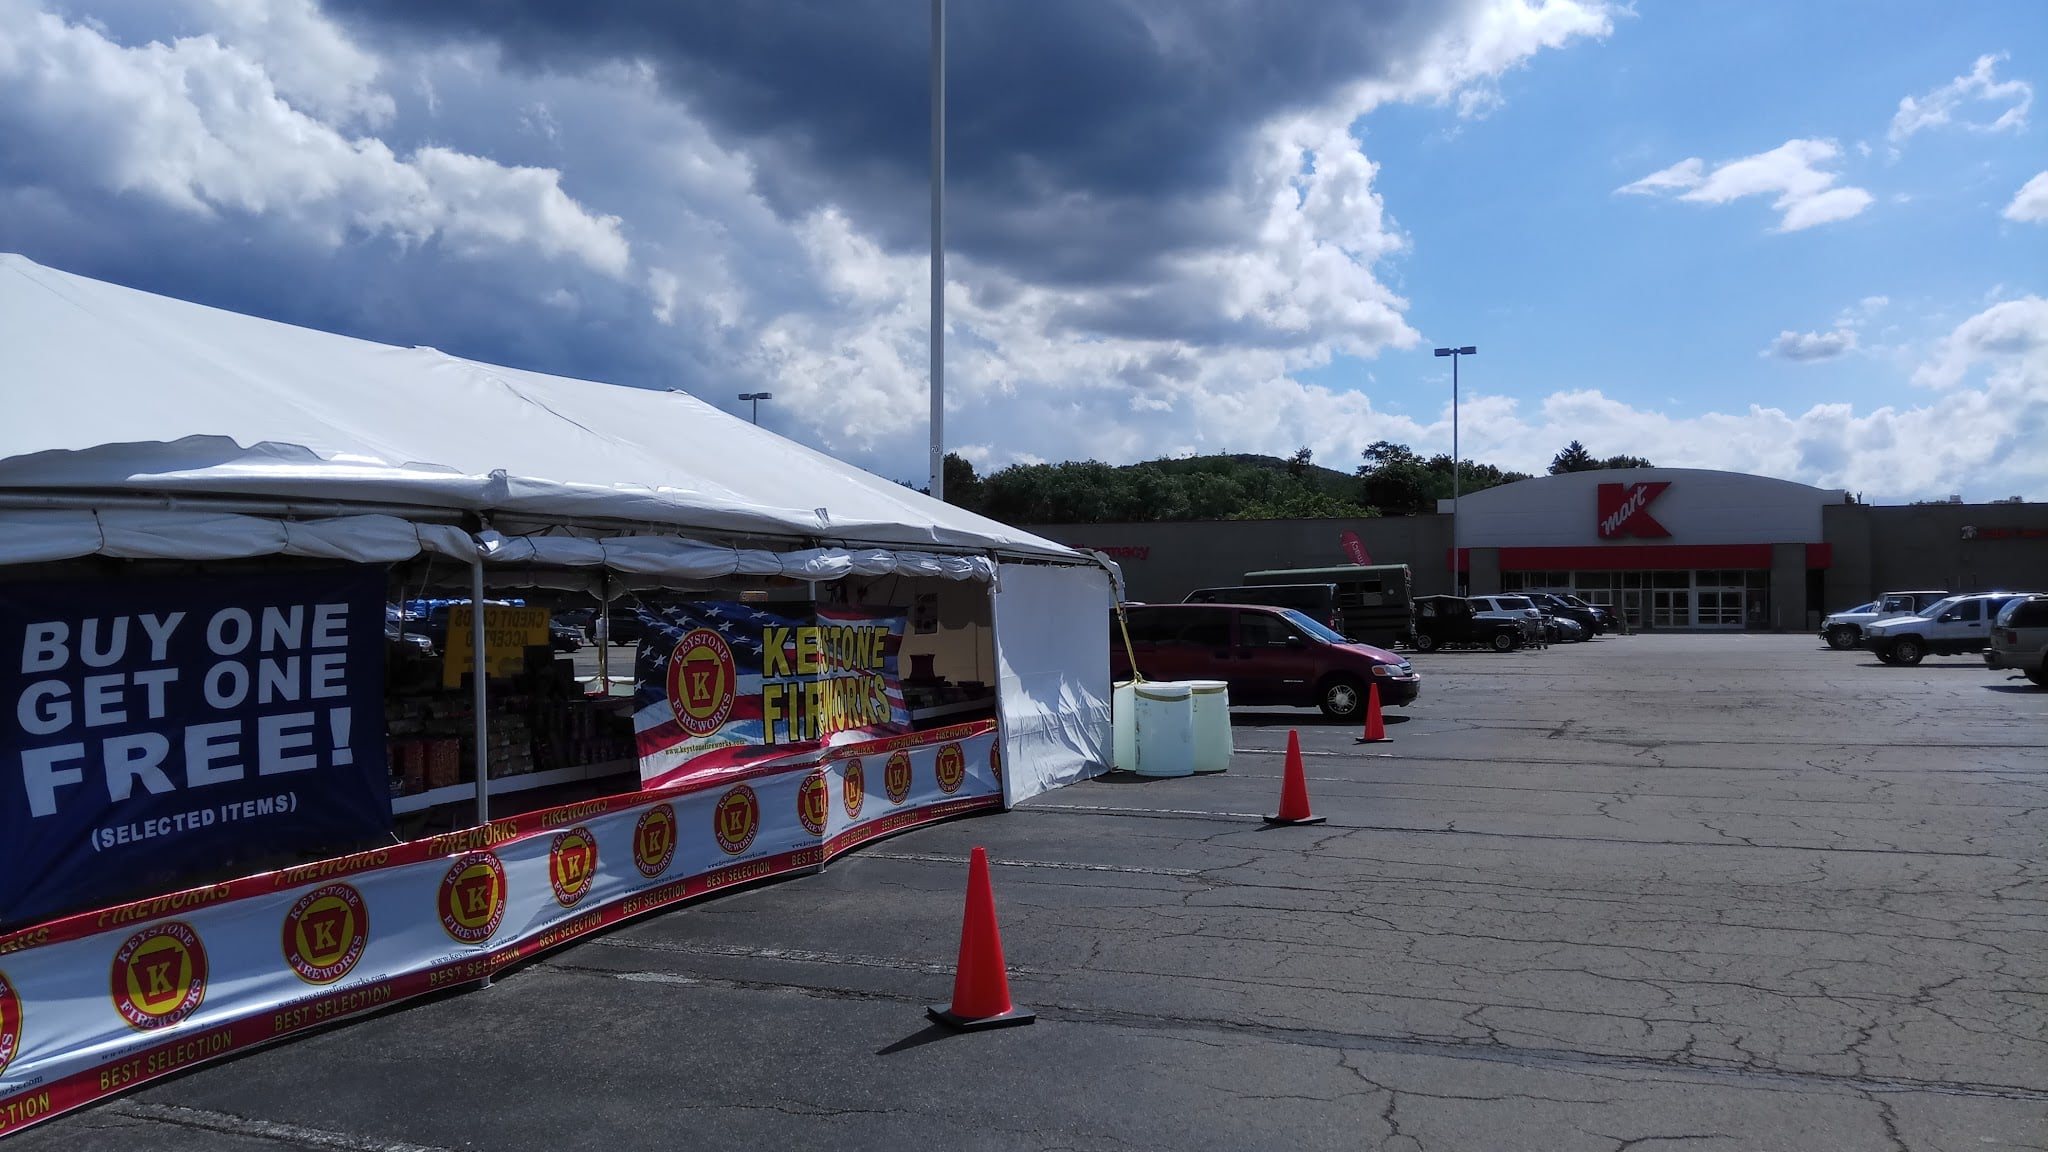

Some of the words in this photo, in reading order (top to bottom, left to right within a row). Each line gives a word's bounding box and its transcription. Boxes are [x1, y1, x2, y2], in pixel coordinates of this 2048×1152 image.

[20, 611, 187, 674] BUY
[206, 603, 349, 656] ONE
[674, 632, 730, 665] KEYSTONE
[762, 625, 890, 678] KESTONE
[16, 668, 179, 735] GET
[203, 652, 347, 710] ONE
[692, 672, 711, 700] K
[674, 692, 731, 732] FIREWORKS
[20, 706, 353, 818] FREE!
[91, 808, 214, 852] (SELECTED
[220, 791, 297, 823] ITEMS)
[428, 820, 518, 855] FIREWORKS
[730, 811, 742, 831] K
[649, 832, 661, 852] K
[792, 852, 810, 865] BEST
[445, 852, 500, 885] KEYSTONE
[567, 854, 581, 880] K
[706, 872, 725, 888] BEST
[728, 861, 770, 882] SELECTION
[290, 886, 358, 920] KEYSTONE
[467, 886, 488, 914] K
[623, 897, 641, 914] BEST
[645, 883, 686, 907] SELECTION
[314, 919, 337, 950] K
[444, 898, 504, 938] FIREWORKS
[118, 924, 194, 963] KEYSTONE
[289, 935, 362, 979] FIREWORKS
[147, 961, 174, 996] K
[429, 966, 462, 987] BEST
[120, 977, 201, 1028] FIREWORKS
[275, 1006, 310, 1031] BEST
[316, 984, 391, 1019] SELECTION
[100, 1060, 141, 1091] BEST
[148, 1030, 232, 1074] SELECTION
